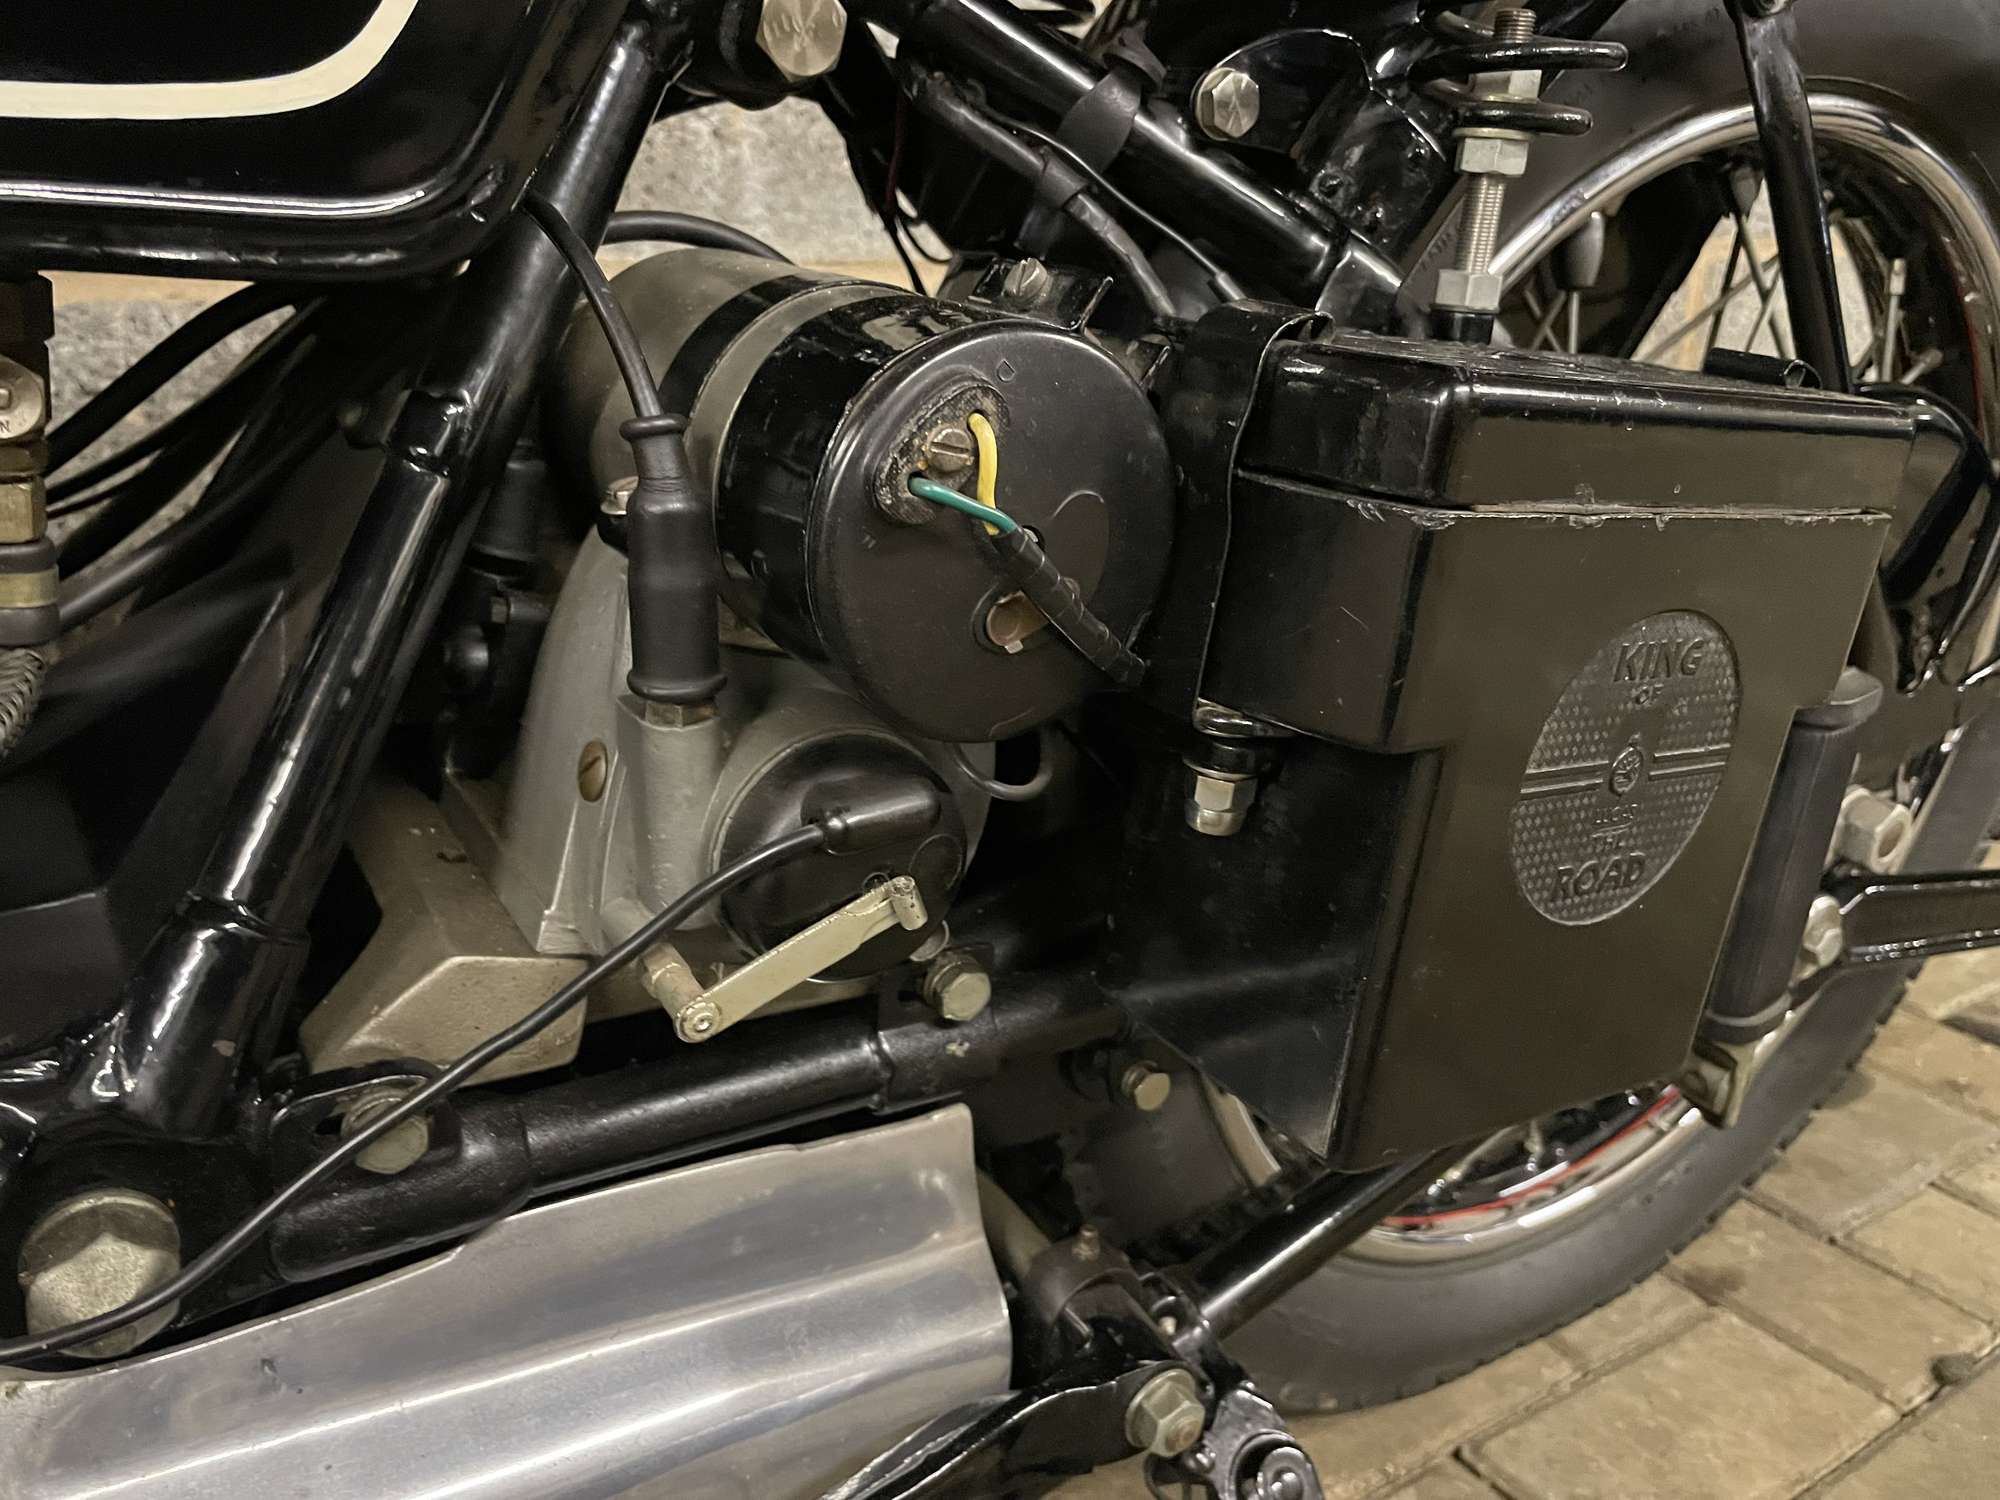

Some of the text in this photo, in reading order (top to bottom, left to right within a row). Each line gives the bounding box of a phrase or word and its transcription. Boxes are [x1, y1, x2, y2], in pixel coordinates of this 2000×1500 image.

[1613, 638, 1704, 682] KING
[1634, 682, 1665, 705] OF
[1549, 851, 1647, 901] ROAD
